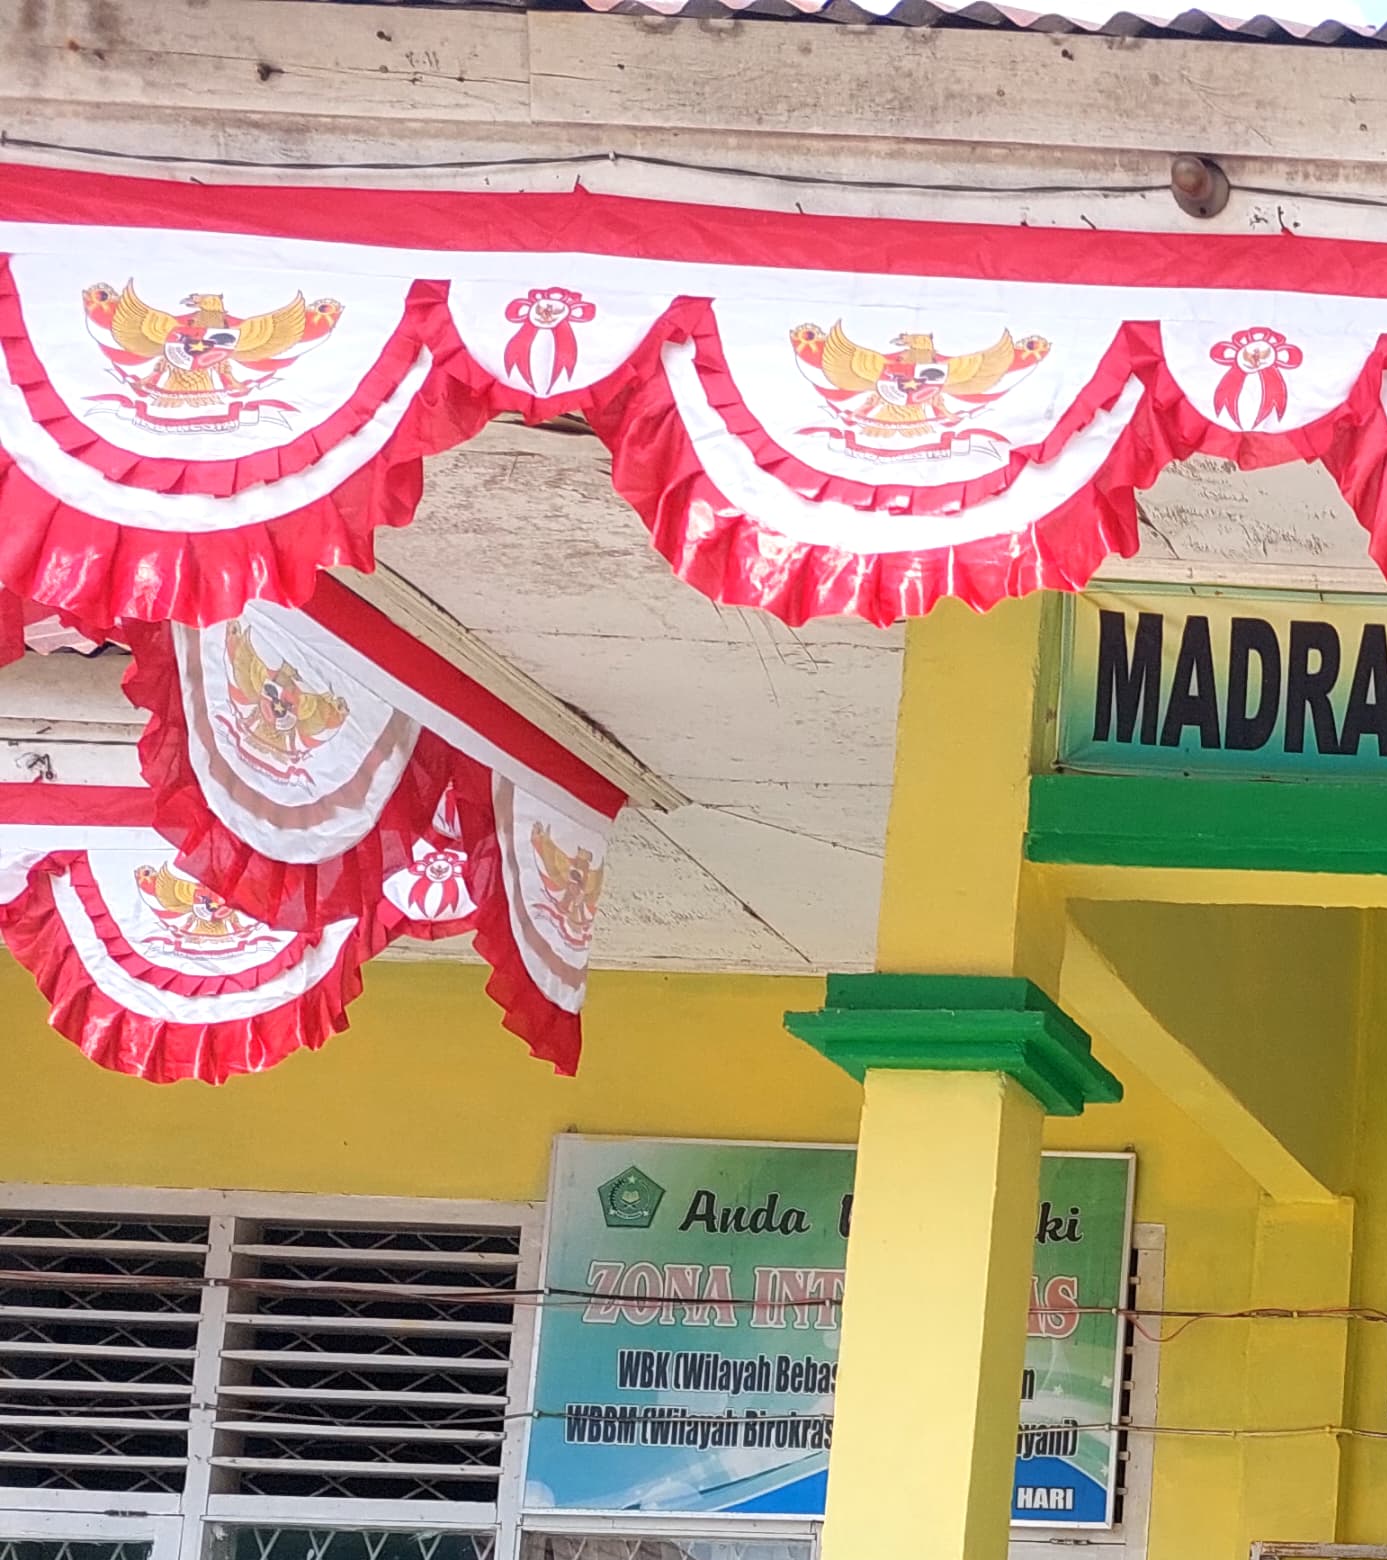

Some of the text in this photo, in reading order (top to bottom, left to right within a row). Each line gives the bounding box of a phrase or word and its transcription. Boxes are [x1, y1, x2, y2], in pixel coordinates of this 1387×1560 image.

[679, 1188, 810, 1237] Anda
[582, 1259, 738, 1327] ZONA
[618, 1350, 670, 1390] WBK
[672, 1351, 771, 1396] (Wilayah
[565, 1403, 638, 1445] WBBM
[641, 1405, 740, 1451] (Wilayah
[1017, 1486, 1074, 1510] HARI
